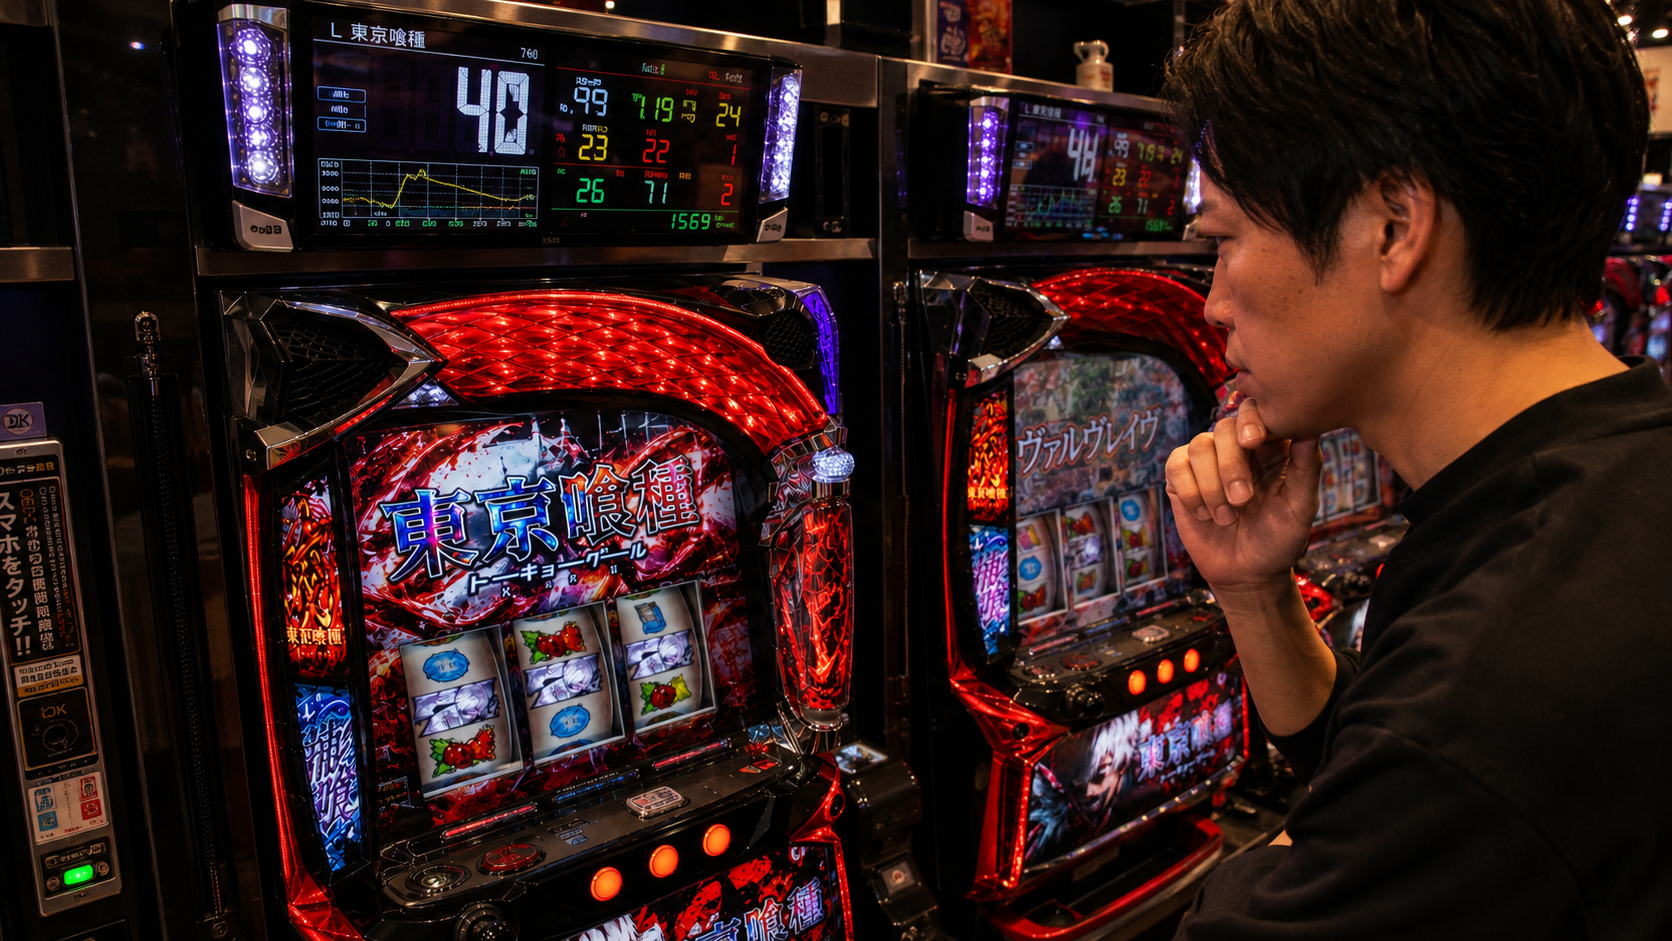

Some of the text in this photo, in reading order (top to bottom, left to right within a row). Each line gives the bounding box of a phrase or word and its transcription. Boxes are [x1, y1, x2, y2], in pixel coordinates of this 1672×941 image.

[330, 22, 426, 49] L 東京喰種
[456, 66, 530, 155] 40
[573, 86, 608, 117] 99
[715, 102, 742, 127] 24
[578, 133, 609, 161] 23
[642, 138, 671, 164] 22
[731, 143, 737, 166] 1
[576, 178, 605, 203] 26
[644, 180, 668, 204] 71
[720, 182, 734, 206] 2
[671, 213, 711, 230] 1569
[1016, 404, 1163, 476] ヴァルヴレイヴ
[379, 454, 701, 582] 東京喰種
[0, 491, 32, 656] スマホをタッチ!!
[468, 542, 647, 595] トーキョーグール
